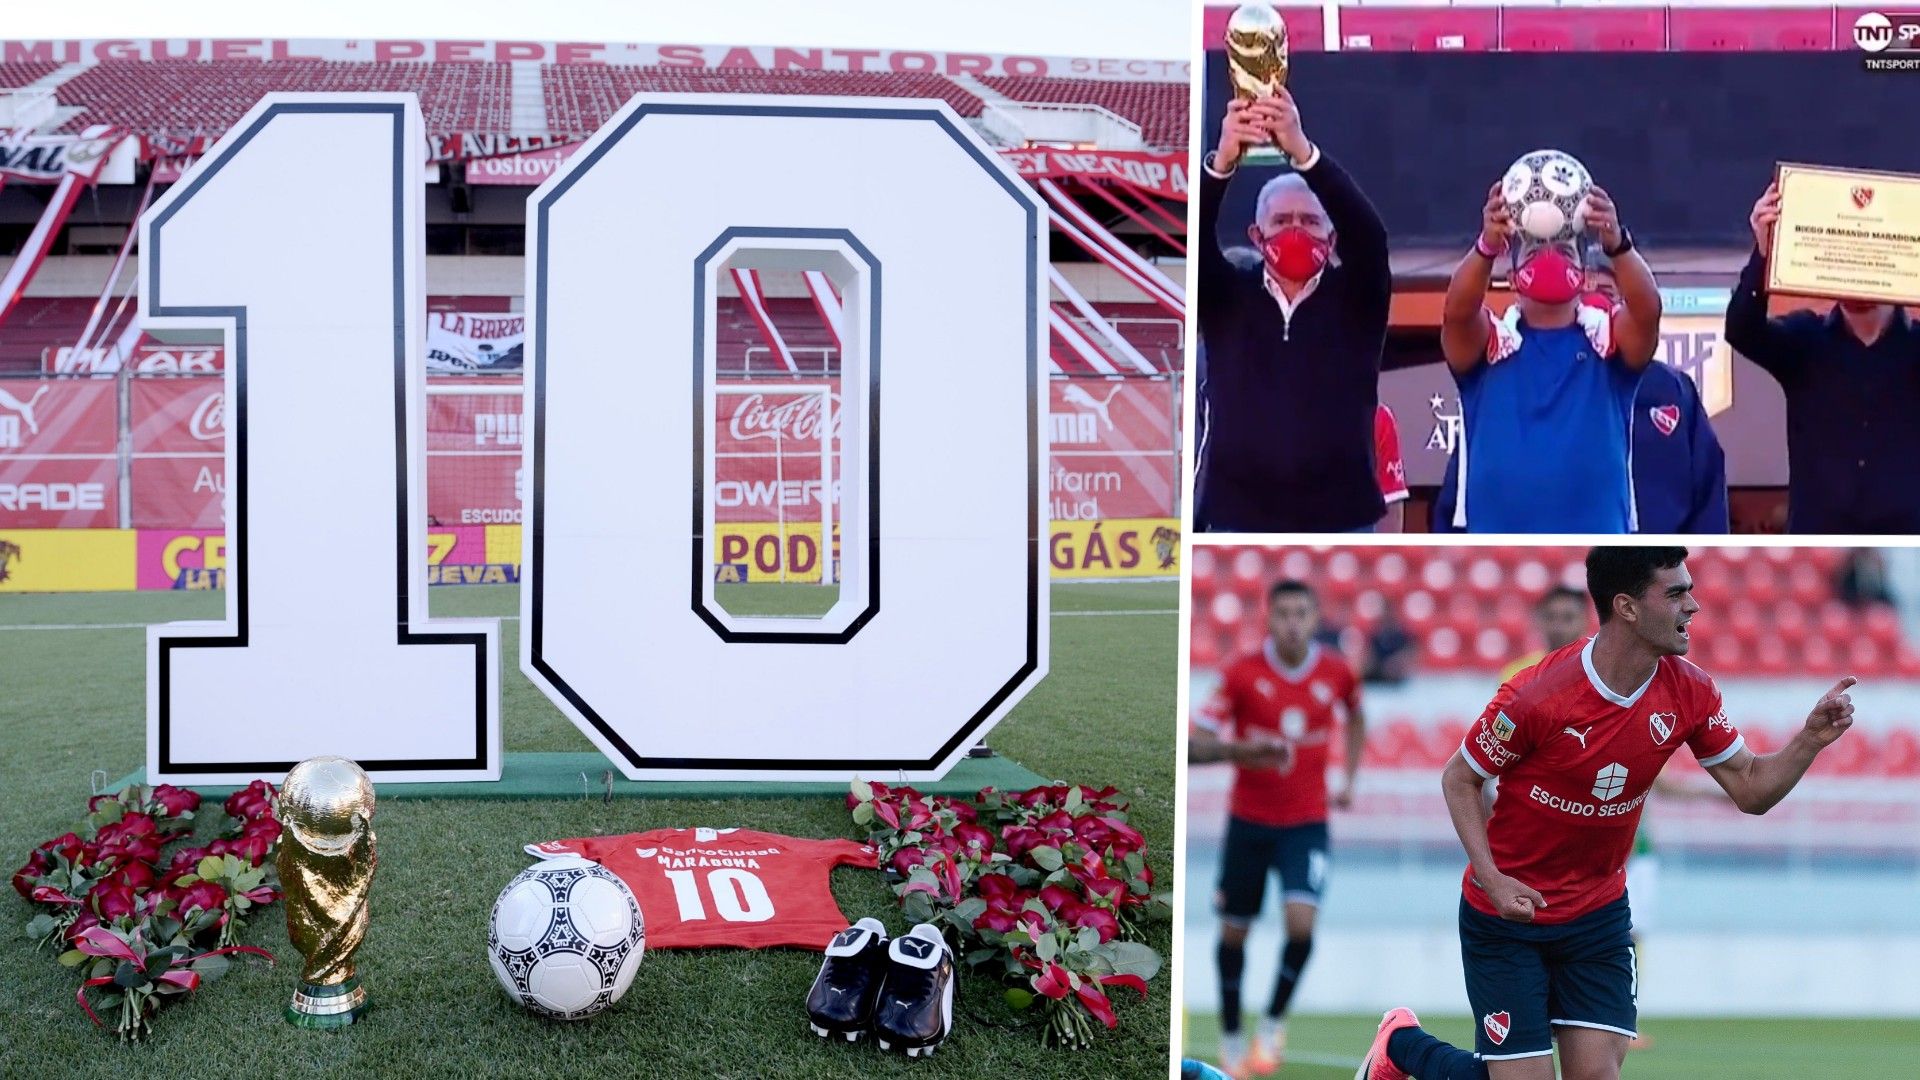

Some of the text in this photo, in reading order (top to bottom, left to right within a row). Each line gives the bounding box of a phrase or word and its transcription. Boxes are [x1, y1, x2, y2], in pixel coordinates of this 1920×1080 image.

[4, 39, 323, 63] MIGUEL
[657, 44, 1048, 77] SANTORO
[138, 91, 1051, 783] 10
[1529, 785, 1595, 817] ESCUDO
[664, 868, 777, 923] 10
